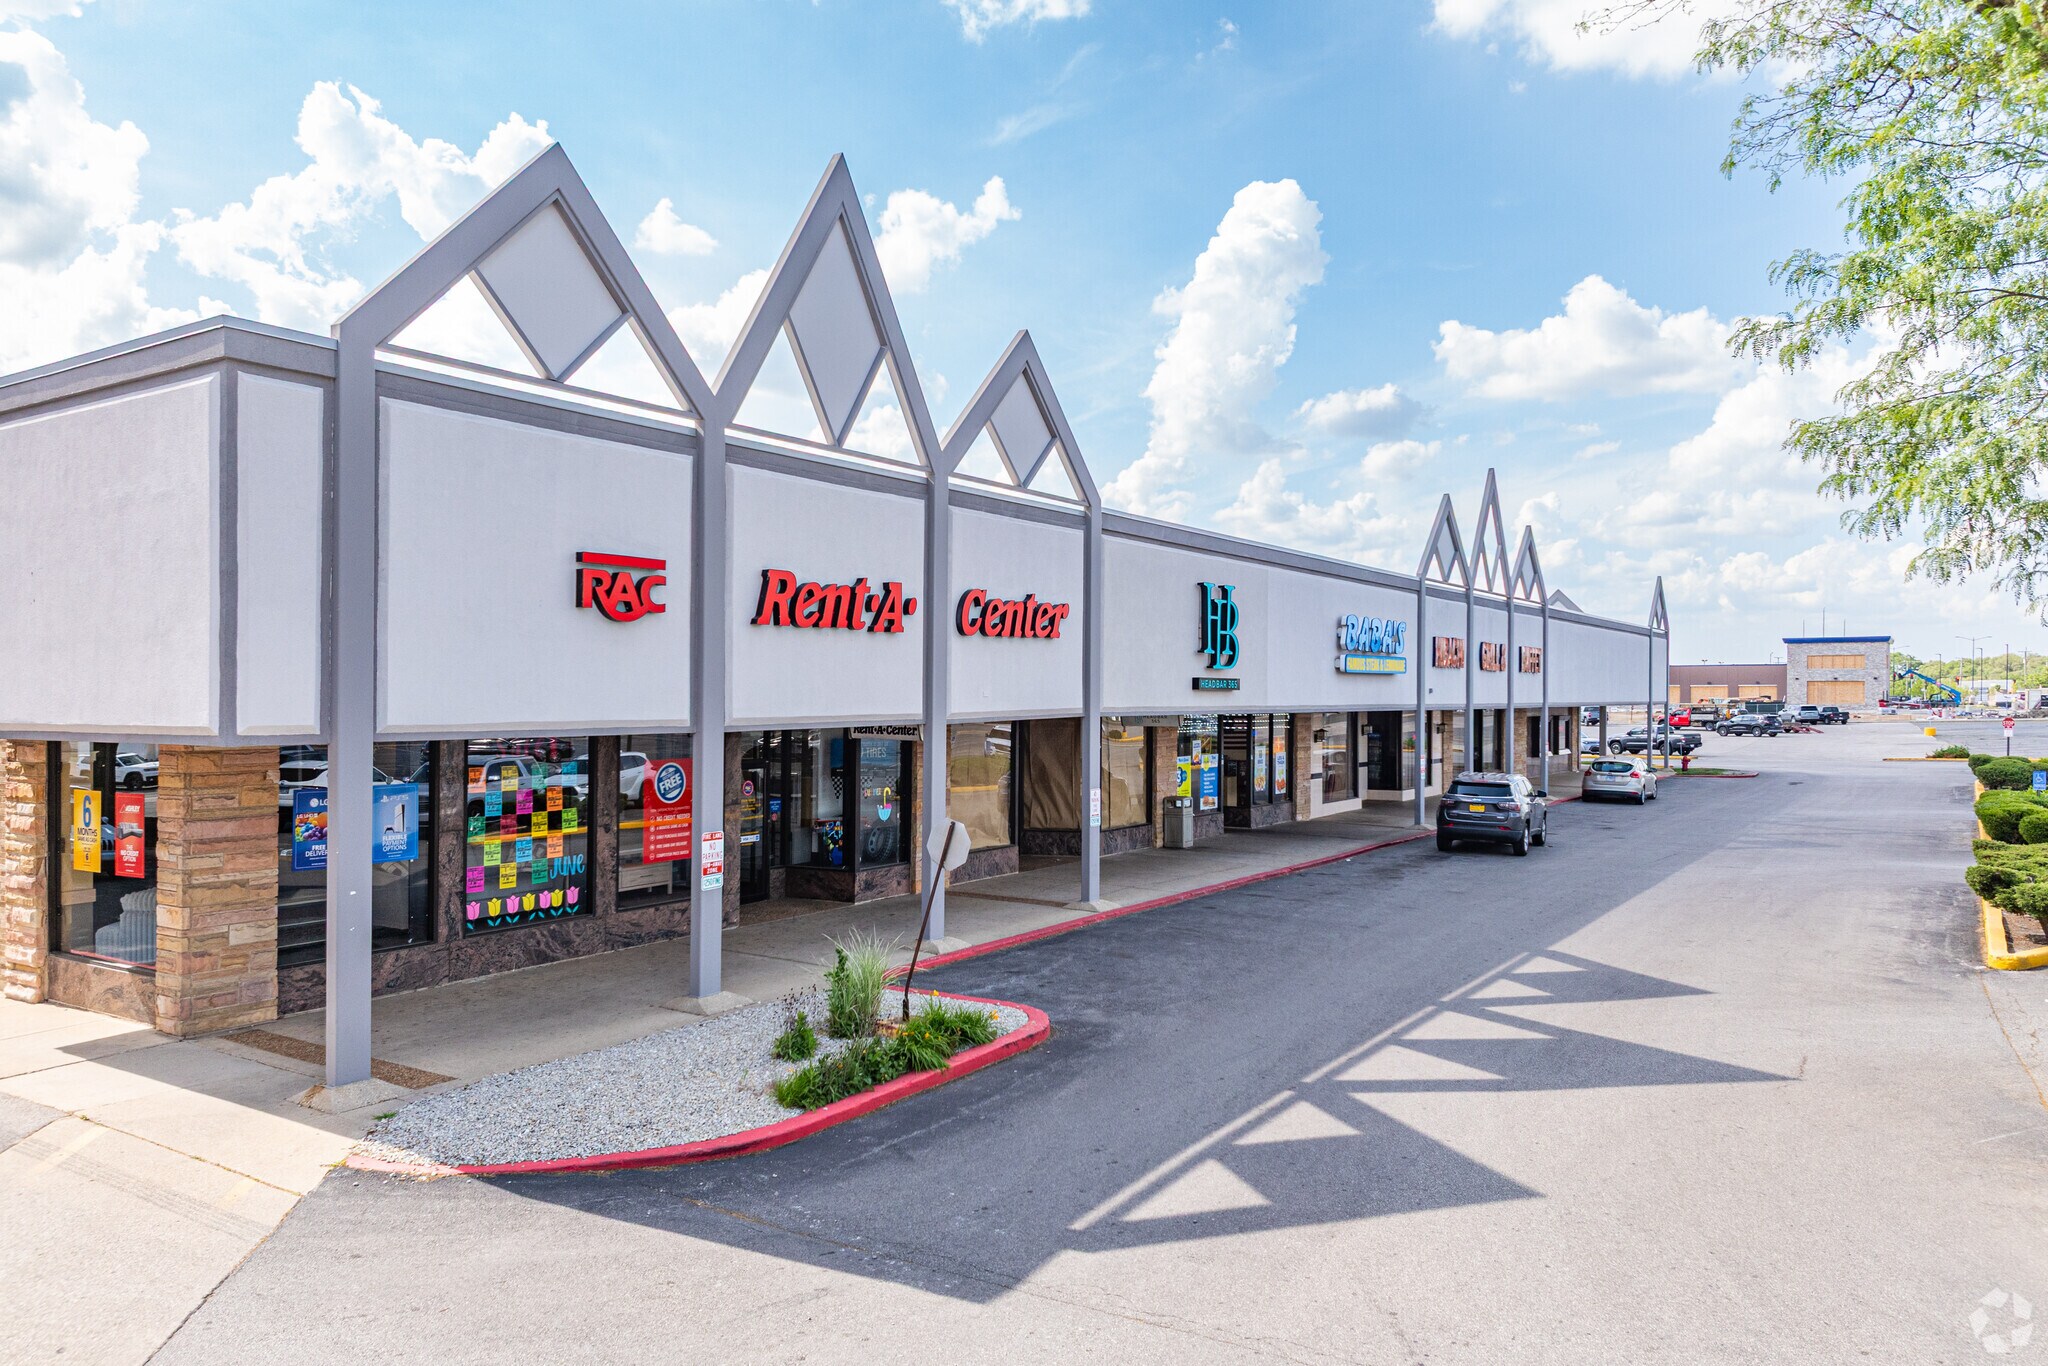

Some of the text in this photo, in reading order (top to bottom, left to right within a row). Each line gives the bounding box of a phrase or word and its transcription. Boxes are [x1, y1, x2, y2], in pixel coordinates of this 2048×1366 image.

[576, 568, 666, 622] RAC
[956, 589, 1069, 638] Center
[1345, 614, 1406, 654] BABA'S
[1201, 680, 1238, 689] HEADBAR 365
[659, 772, 682, 794] FREE
[83, 794, 92, 828] 6
[77, 827, 98, 837] MONTHS
[702, 850, 723, 860] PARKING
[709, 842, 716, 851] NO
